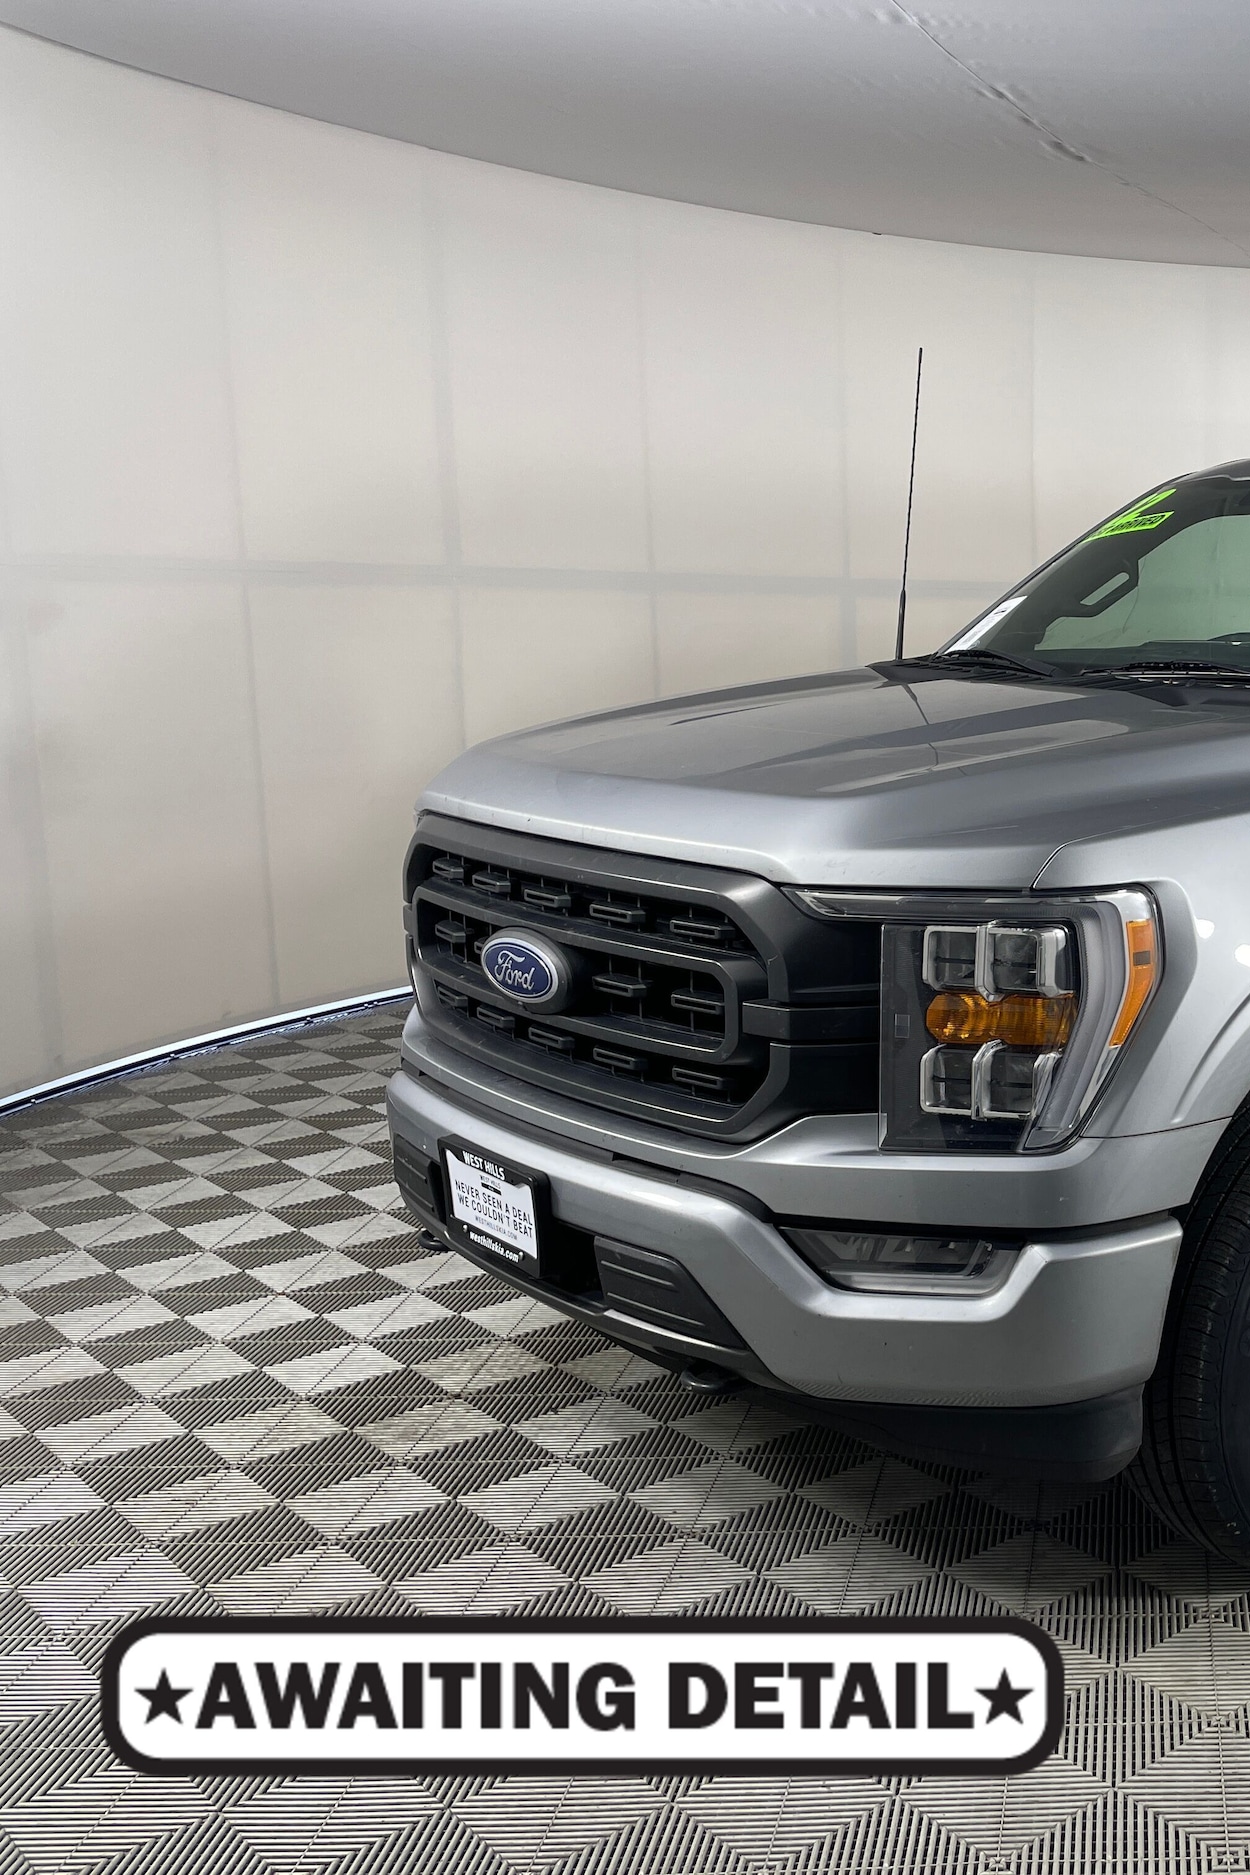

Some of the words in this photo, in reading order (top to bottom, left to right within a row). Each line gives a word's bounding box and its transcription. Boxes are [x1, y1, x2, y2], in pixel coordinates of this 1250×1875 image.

[494, 950, 536, 990] Ford
[462, 1150, 483, 1169] WEST
[484, 1159, 506, 1181] HILLS
[455, 1179, 480, 1201] NEVER
[482, 1192, 502, 1212] SEEN
[505, 1203, 511, 1215] A
[512, 1207, 533, 1226] DEAL
[458, 1193, 470, 1208] WE
[471, 1200, 510, 1227] COULDN'T
[513, 1220, 533, 1239] BEAT
[469, 1231, 519, 1263] westhillskia.com
